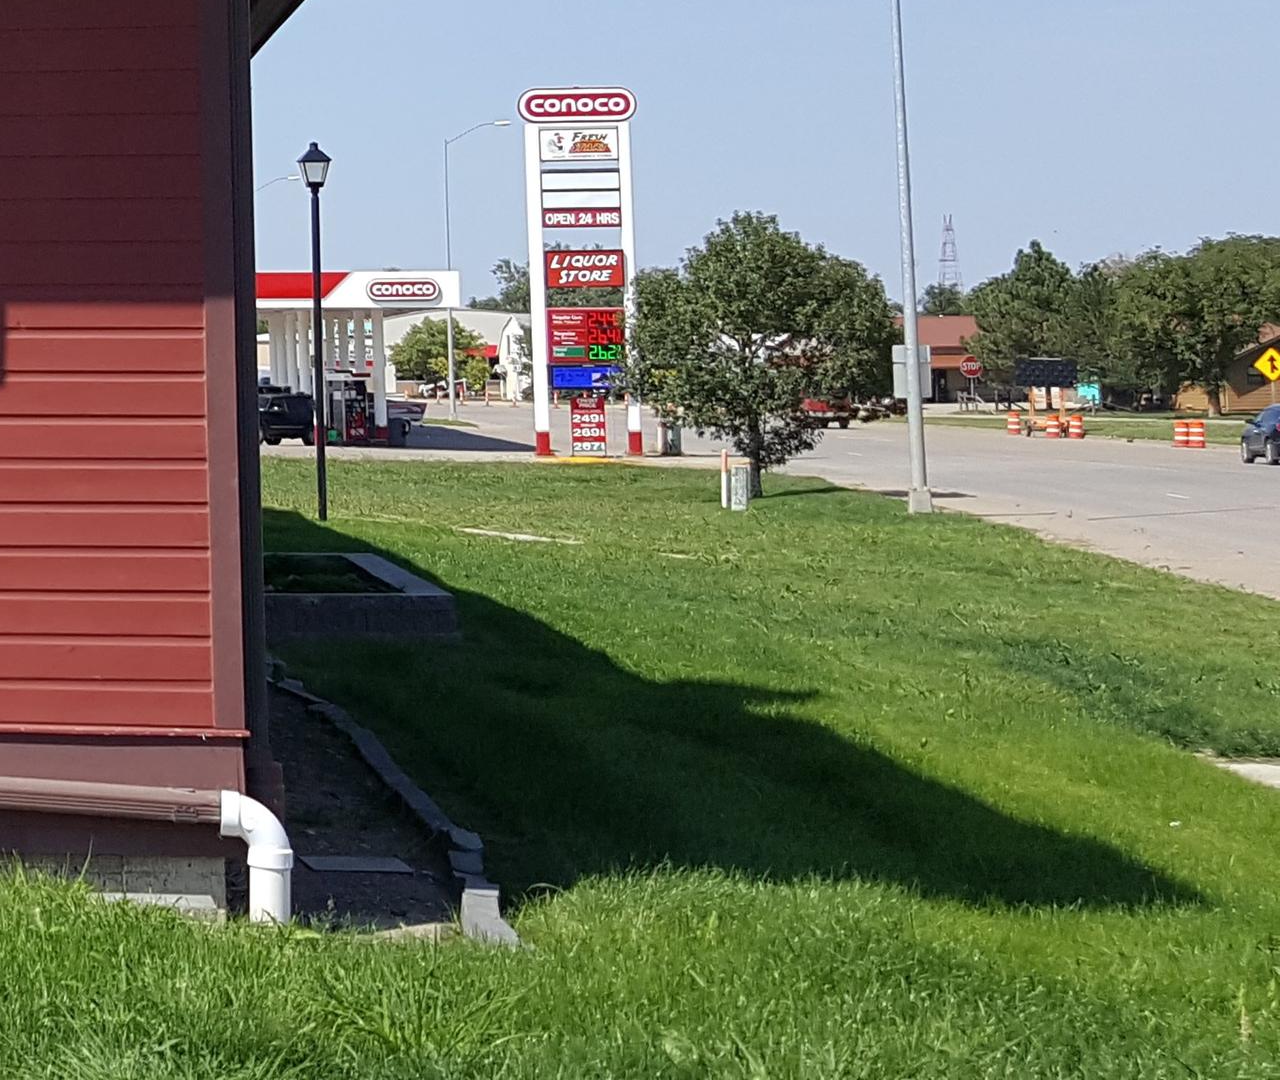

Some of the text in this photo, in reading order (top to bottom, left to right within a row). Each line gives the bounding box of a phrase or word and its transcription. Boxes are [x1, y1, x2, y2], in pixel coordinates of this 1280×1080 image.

[529, 97, 626, 114] conoco
[545, 212, 620, 225] OPEN 24 HRS
[550, 254, 618, 269] LIQUOR
[559, 269, 613, 284] STORE
[372, 284, 435, 296] conoco
[962, 361, 981, 370] STOP
